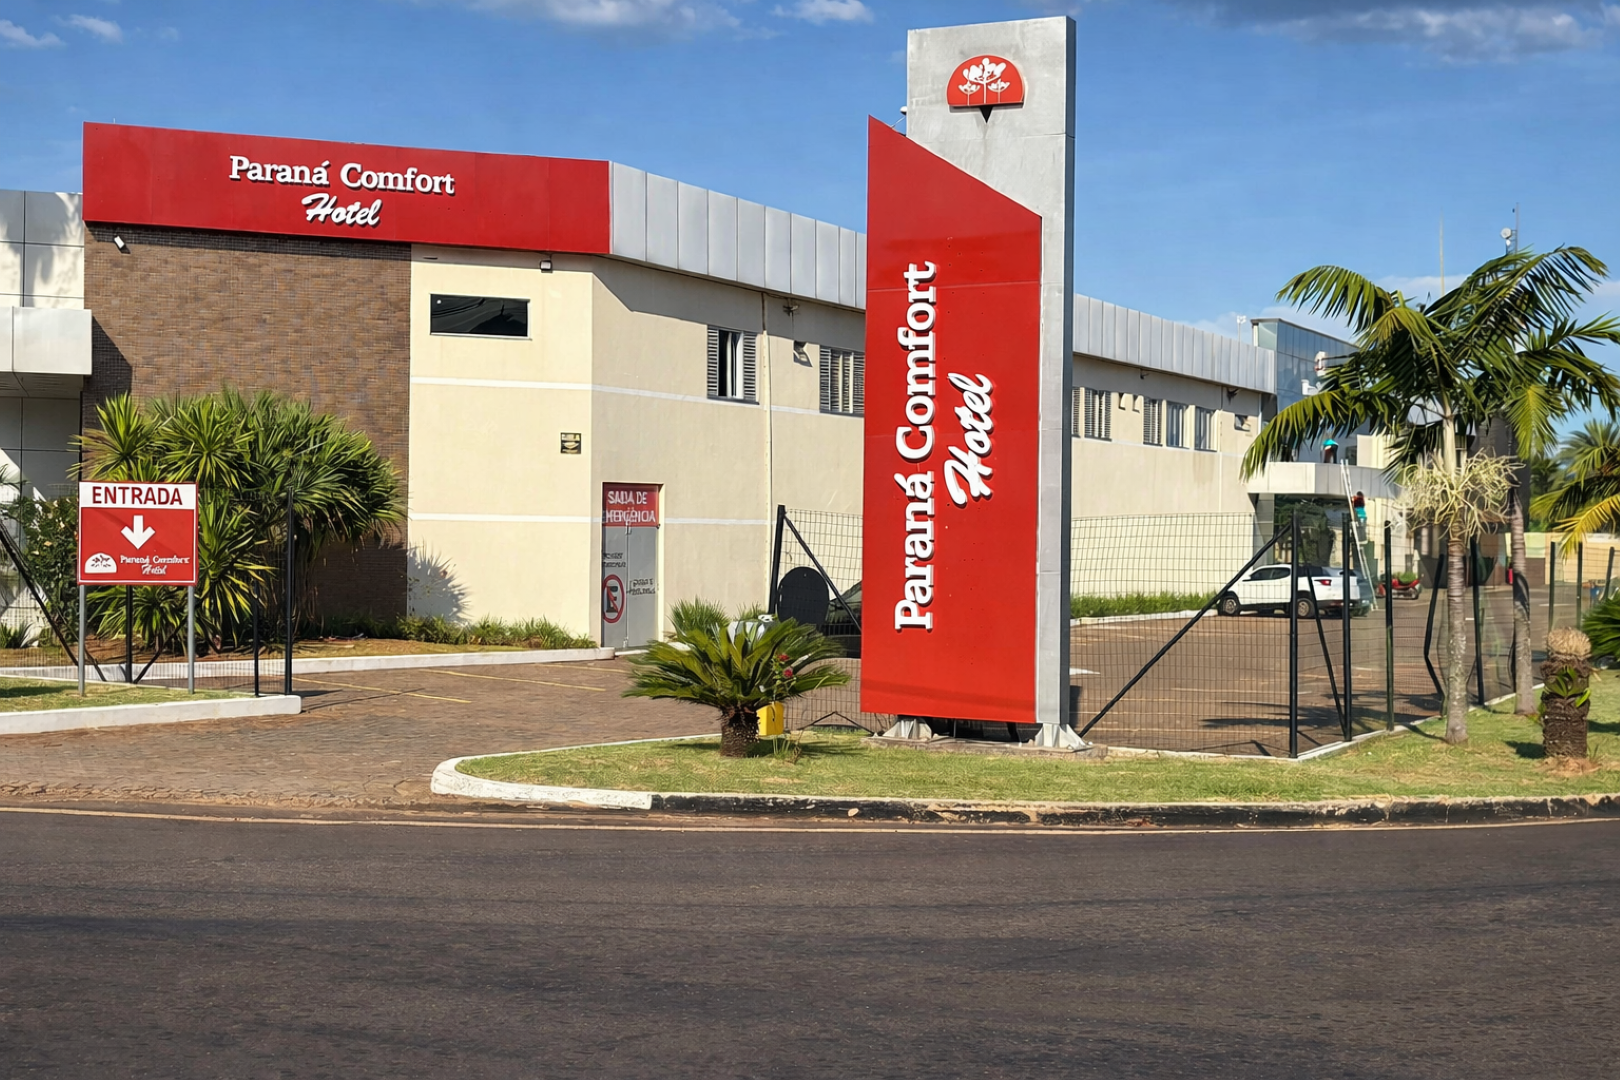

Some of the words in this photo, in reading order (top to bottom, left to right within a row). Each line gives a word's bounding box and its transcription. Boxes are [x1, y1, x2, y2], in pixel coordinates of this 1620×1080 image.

[229, 155, 330, 186] Paraná
[340, 162, 455, 195] Comfort
[301, 192, 382, 226] Hotel
[895, 260, 937, 462] Comfort
[943, 372, 994, 505] Hotel
[92, 486, 183, 505] ENTRADA
[635, 491, 648, 505] DE
[894, 470, 935, 631] Paraná
